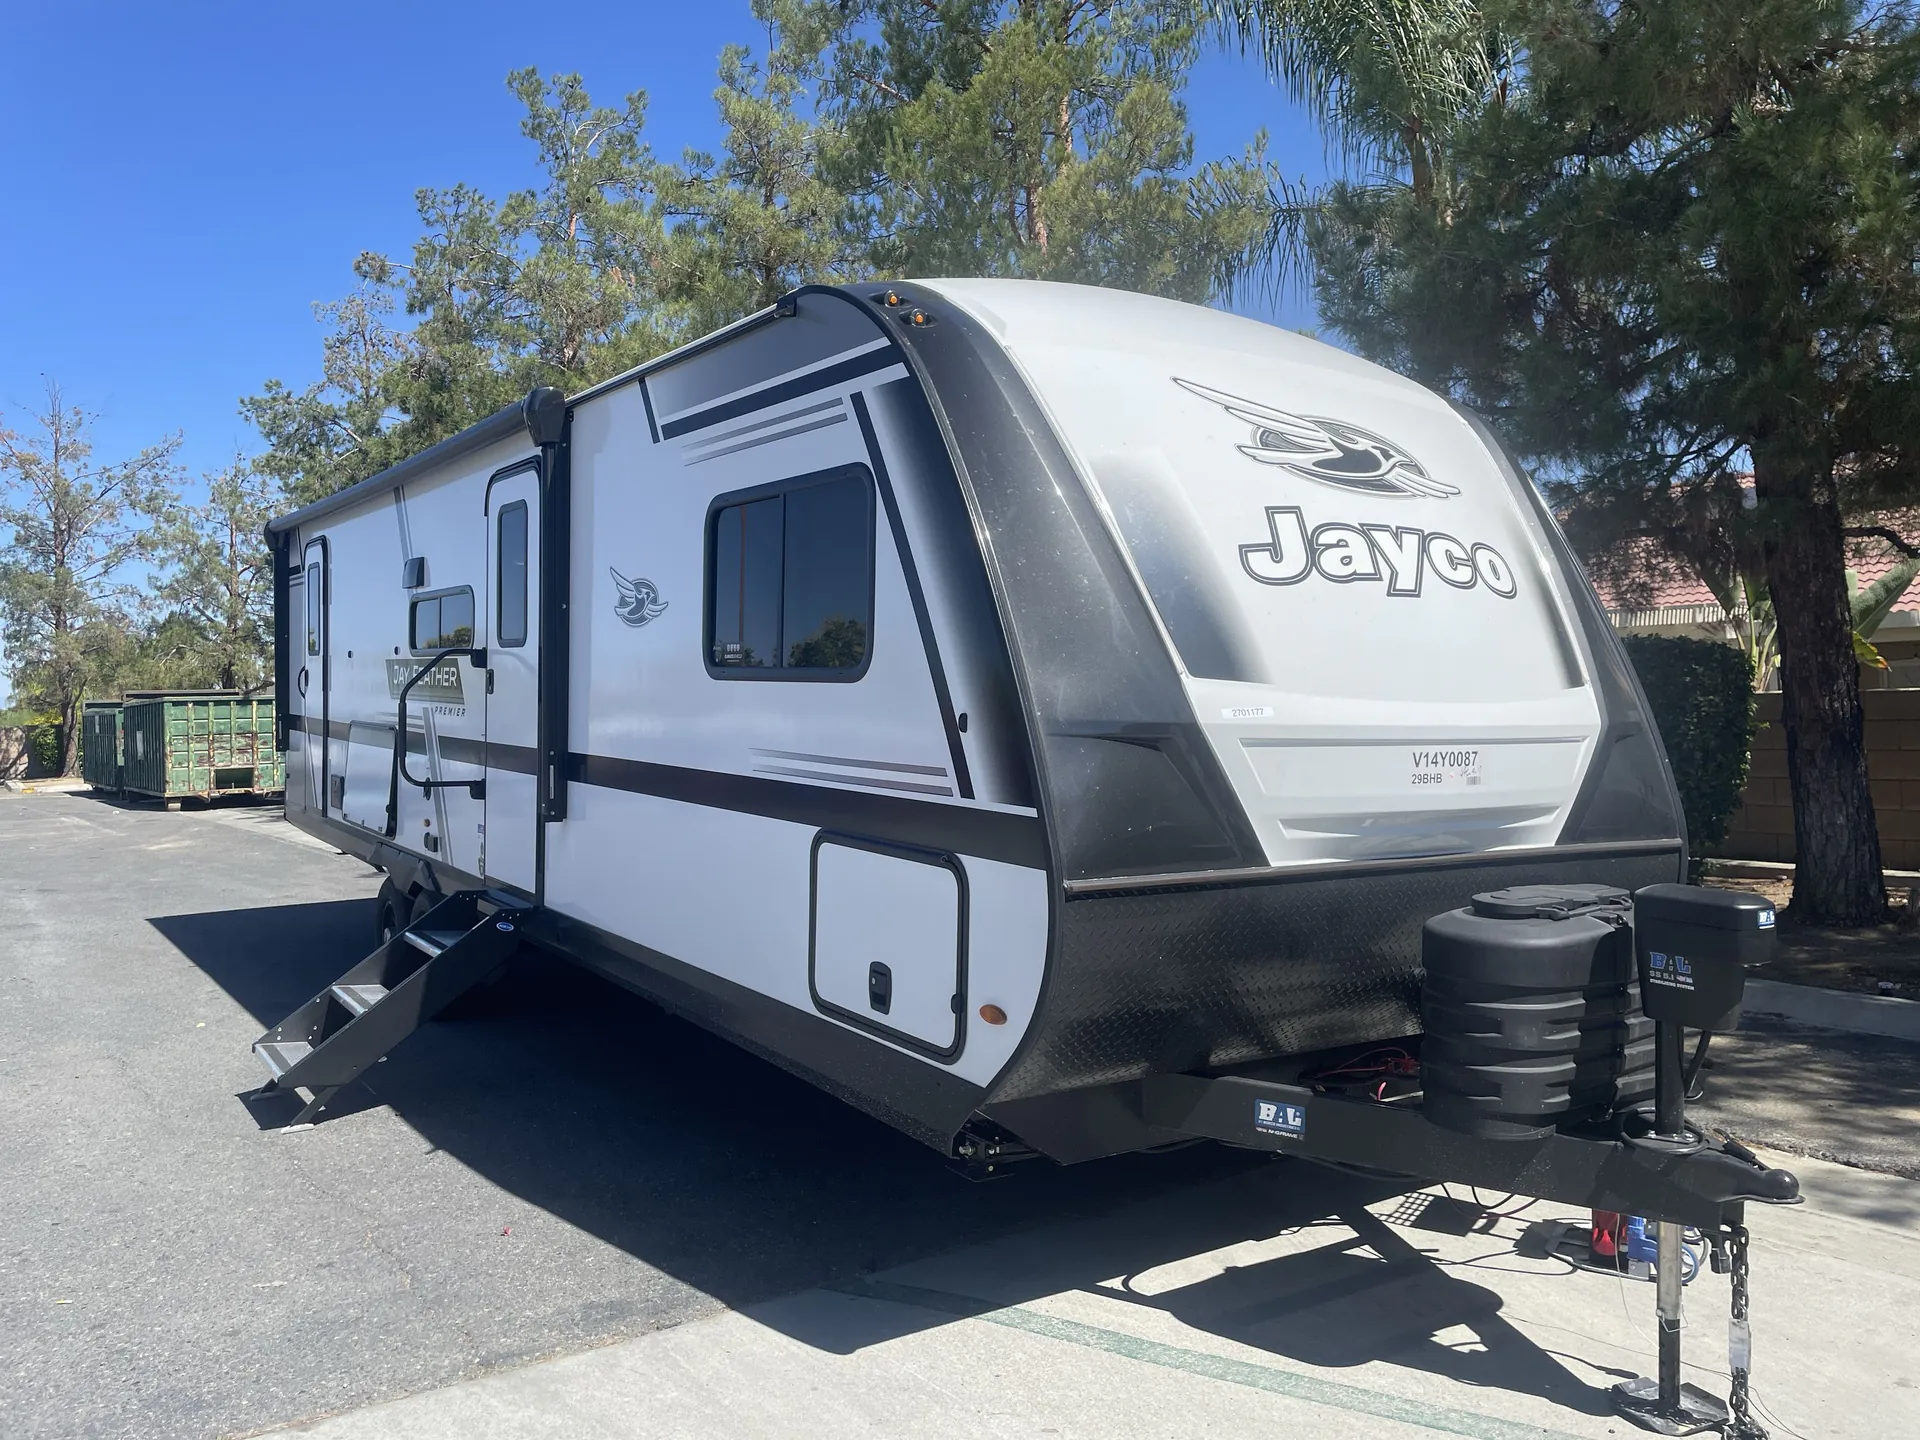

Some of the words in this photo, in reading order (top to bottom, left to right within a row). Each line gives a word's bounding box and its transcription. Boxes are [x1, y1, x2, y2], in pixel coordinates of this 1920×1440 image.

[1238, 505, 1518, 599] Jayco
[393, 665, 410, 685] JAY
[434, 705, 466, 717] PREMIER
[1231, 708, 1264, 717] 2701177
[1412, 751, 1478, 768] V14Y0087
[1411, 773, 1443, 785] 29BHB
